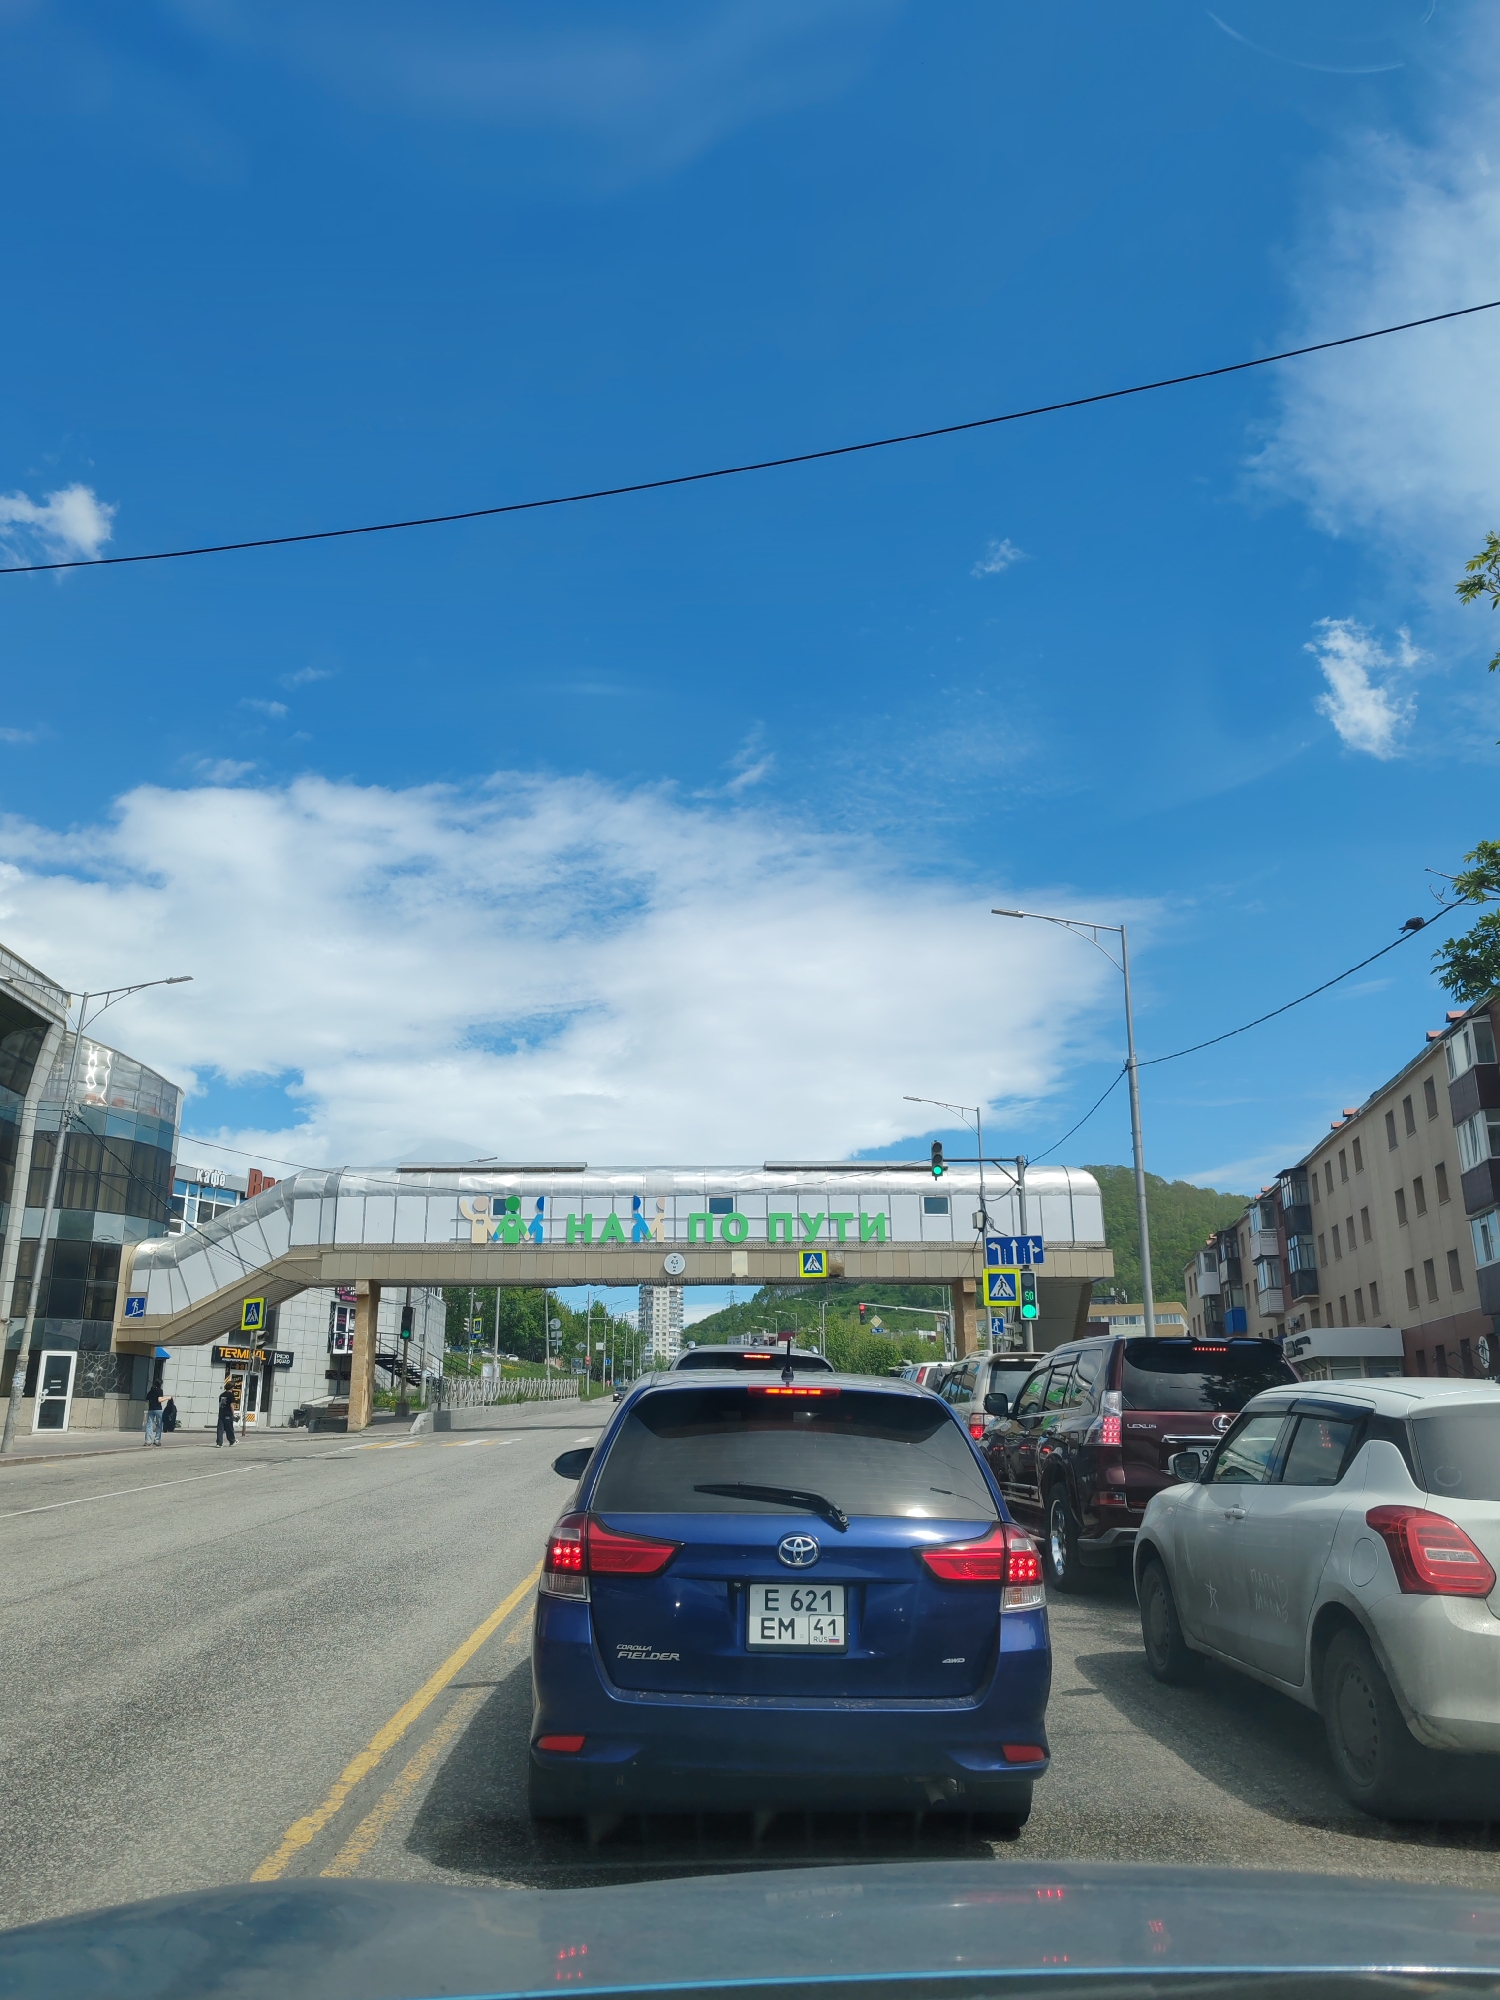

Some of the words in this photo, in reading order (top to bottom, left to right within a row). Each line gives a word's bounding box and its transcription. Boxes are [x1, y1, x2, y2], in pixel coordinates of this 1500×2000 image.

[196, 1168, 226, 1188] кафе
[688, 1212, 749, 1244] ПО
[768, 1212, 887, 1243] ПУТИ
[790, 1589, 832, 1613] 621
[760, 1617, 796, 1640] ЕМ
[813, 1618, 837, 1636] 41
[616, 1644, 653, 1652] COROLLA
[616, 1651, 681, 1662] FIELDER
